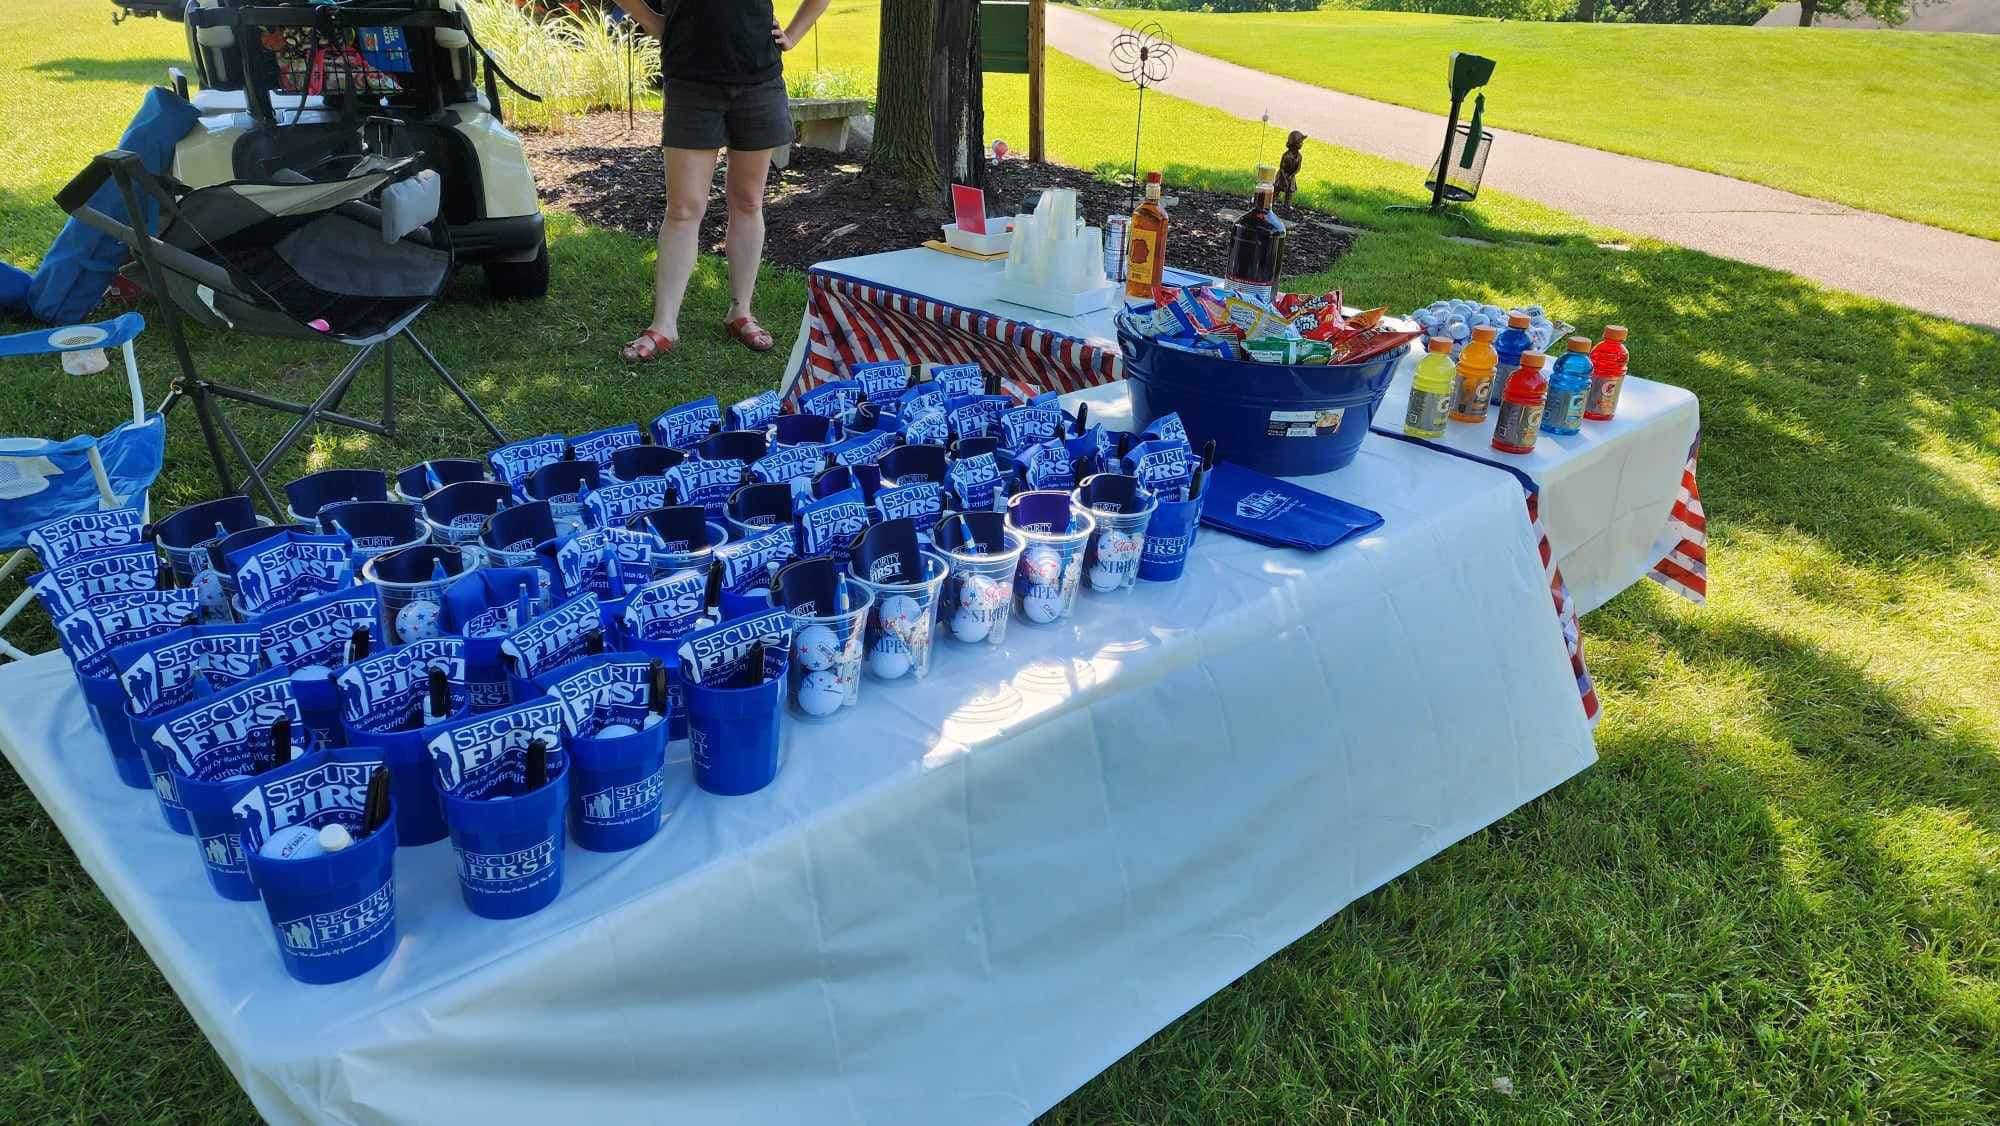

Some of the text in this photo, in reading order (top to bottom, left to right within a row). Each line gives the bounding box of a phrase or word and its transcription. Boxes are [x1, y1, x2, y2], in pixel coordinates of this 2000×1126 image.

[865, 368, 905, 380] SECURI
[868, 377, 906, 393] FIRS
[944, 367, 982, 380] SECURI
[945, 377, 983, 396] FIRS
[668, 406, 720, 427] SECURIT
[744, 403, 780, 428] FIRS
[959, 401, 1007, 419] SECURIT
[1009, 411, 1062, 425] SECURIT
[671, 417, 720, 438] FIRS
[1015, 421, 1058, 440] FIRS
[502, 442, 565, 462] SECURIT
[509, 453, 564, 476] FIRS
[761, 445, 822, 469] SECURIT
[1144, 448, 1185, 468] CURIT
[687, 466, 742, 486] FIRS
[765, 459, 820, 482] FIRS
[600, 478, 668, 503] SECURIT
[605, 493, 664, 514] FIRS
[882, 484, 940, 508] SECURI
[811, 503, 865, 526] SECURIT
[887, 496, 941, 520] FIRS
[578, 525, 648, 552] SECURIT
[726, 525, 793, 560] SECURIT
[817, 517, 868, 540] FIRS
[260, 544, 345, 571] SECURITY
[580, 543, 652, 571] FST
[732, 541, 795, 576] FIRS
[1145, 544, 1186, 555] IRST
[57, 552, 159, 587] SECURIT
[266, 560, 345, 588] FIRST
[64, 569, 159, 607] FIRS
[92, 586, 200, 618] SECURIT
[636, 575, 704, 611] CURIT
[99, 601, 199, 636] FIRS
[640, 589, 704, 621] IRS
[260, 601, 376, 648] SECURITY
[514, 593, 600, 650] SECURIT
[694, 612, 786, 659] SECURIT
[523, 608, 601, 668] FIRS
[699, 627, 793, 671] FIST
[156, 636, 260, 669] SECURIT
[362, 640, 465, 681] SECURIT
[160, 652, 260, 688] FRS
[172, 681, 292, 741] SECURIT
[568, 681, 650, 721] FST
[453, 704, 562, 750] SECURIT
[460, 723, 562, 773] FIRS
[264, 764, 374, 807] SECURI
[618, 785, 660, 812] FIR
[271, 784, 368, 831] FIRS
[469, 850, 555, 881] FIRST
[315, 879, 394, 927] SECURIT
[318, 899, 390, 941] FIRS
